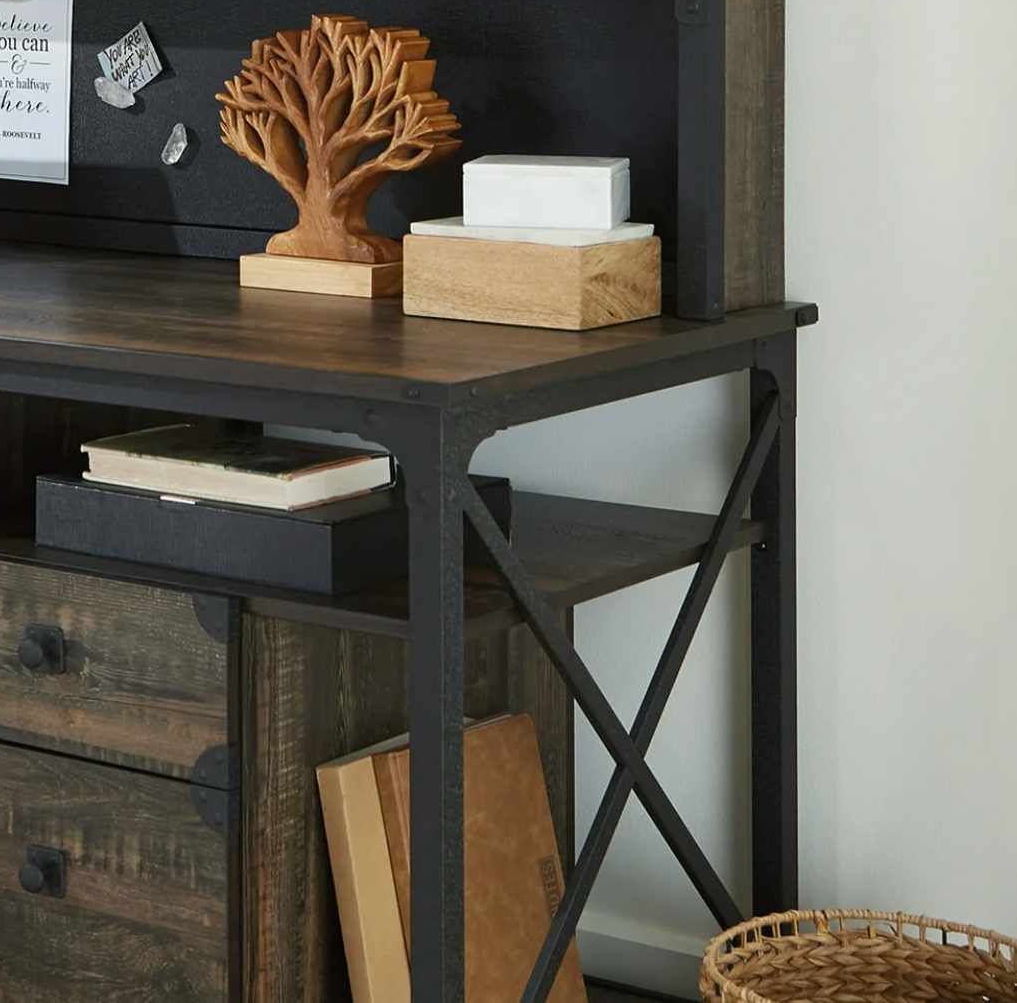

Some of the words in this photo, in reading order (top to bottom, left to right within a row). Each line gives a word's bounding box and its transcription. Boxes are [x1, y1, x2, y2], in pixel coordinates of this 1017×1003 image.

[22, 37, 49, 52] can
[103, 44, 122, 70] YOU
[123, 29, 142, 55] ARE
[11, 54, 27, 75] &
[111, 52, 135, 81] WHAT
[135, 43, 149, 67] YOU
[15, 77, 51, 93] halfway
[2, 130, 42, 140] ROOSEVELT
